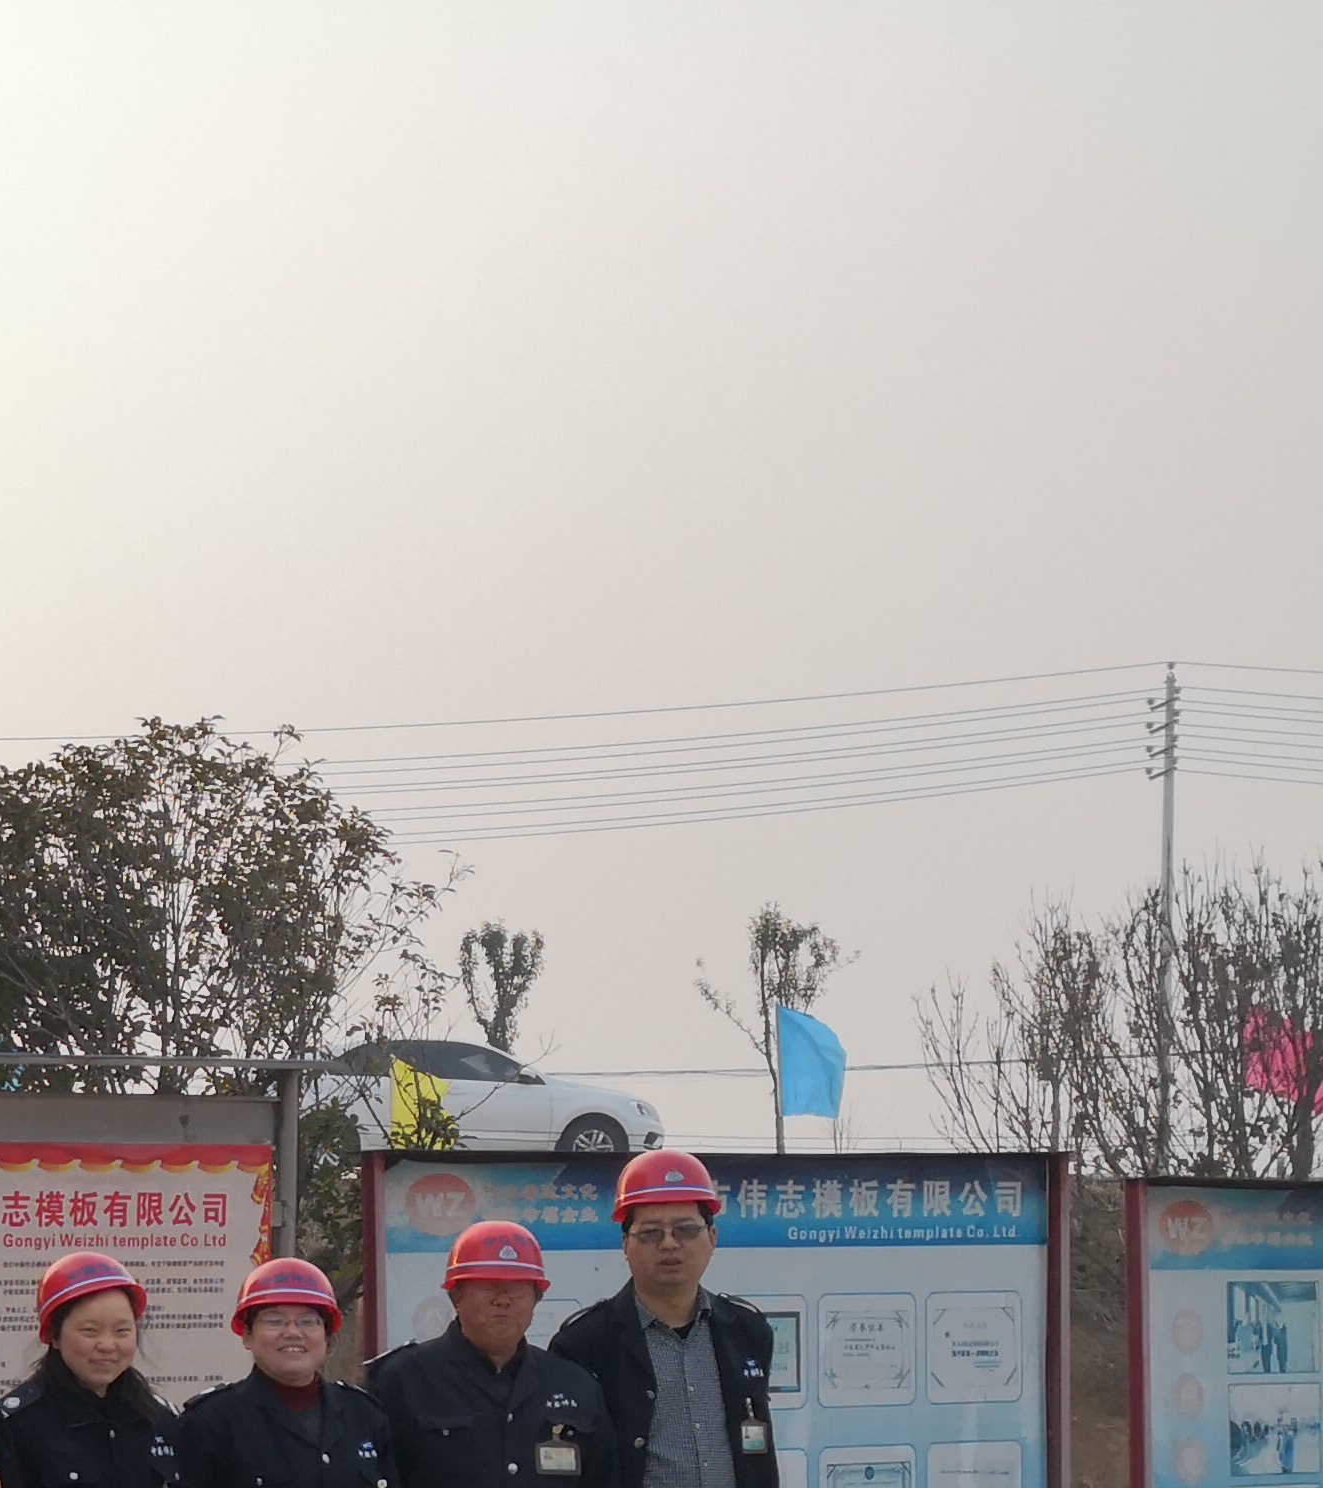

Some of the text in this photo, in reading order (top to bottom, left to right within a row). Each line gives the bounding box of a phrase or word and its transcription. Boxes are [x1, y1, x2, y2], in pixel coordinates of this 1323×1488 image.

[413, 1191, 467, 1219] WZ
[2, 1233, 56, 1250] Gongyi
[60, 1234, 109, 1248] Weizhi
[112, 1234, 177, 1248] template
[787, 1226, 841, 1243] Gongyi
[844, 1225, 894, 1240] Weizhi
[897, 1225, 963, 1241] template
